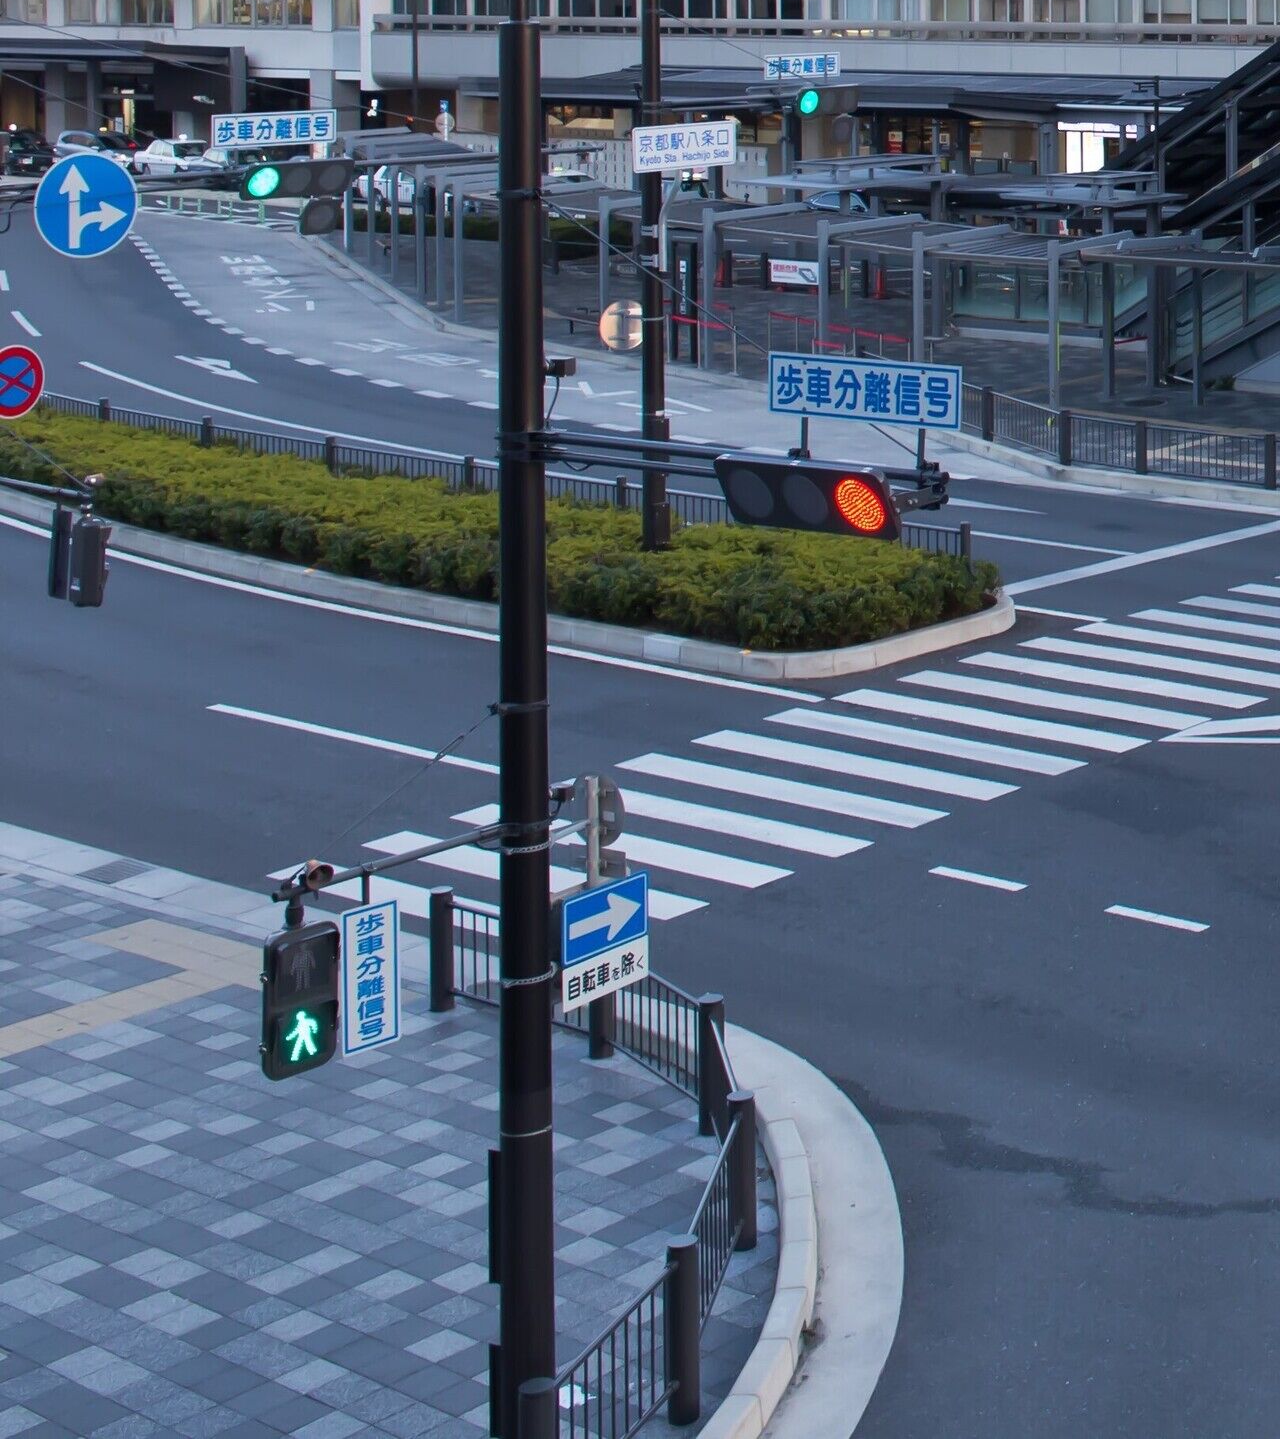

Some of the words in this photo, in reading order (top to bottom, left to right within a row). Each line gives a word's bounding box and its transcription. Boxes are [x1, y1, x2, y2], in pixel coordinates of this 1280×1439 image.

[217, 116, 330, 143] 歩車分離信号
[639, 129, 729, 153] 京都駅八条口
[640, 155, 661, 166] Kyoto
[682, 151, 710, 161] Hachijo
[713, 148, 730, 159] Side
[777, 363, 952, 419] 歩車分離信号
[356, 913, 386, 1041] 歩車分離信号
[568, 952, 644, 1001] 自転車を除く
